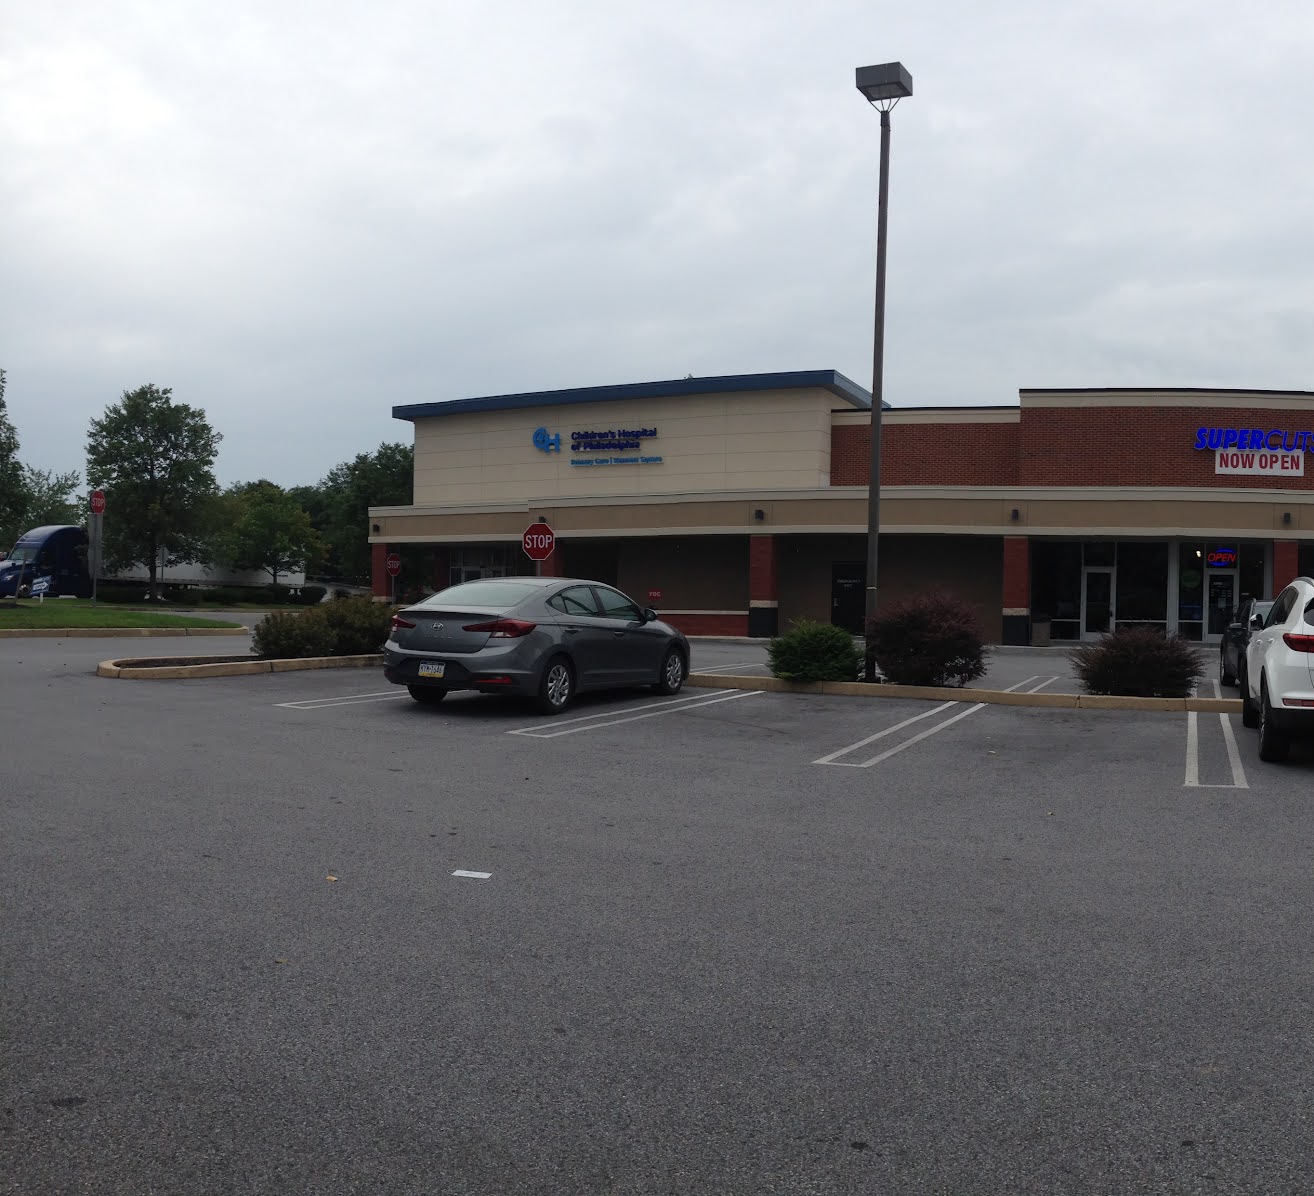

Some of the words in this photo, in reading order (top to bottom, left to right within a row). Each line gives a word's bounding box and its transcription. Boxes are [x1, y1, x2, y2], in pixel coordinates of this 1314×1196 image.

[571, 430, 616, 441] Children's
[618, 427, 657, 440] Hospital
[571, 442, 581, 450] of
[584, 441, 640, 451] Philadelphia
[1219, 453, 1255, 469] NOW
[1259, 454, 1300, 470] OPEN
[92, 497, 105, 506] STOP
[525, 534, 552, 549] STOP
[1207, 553, 1237, 563] OPEN
[387, 560, 401, 569] STOP
